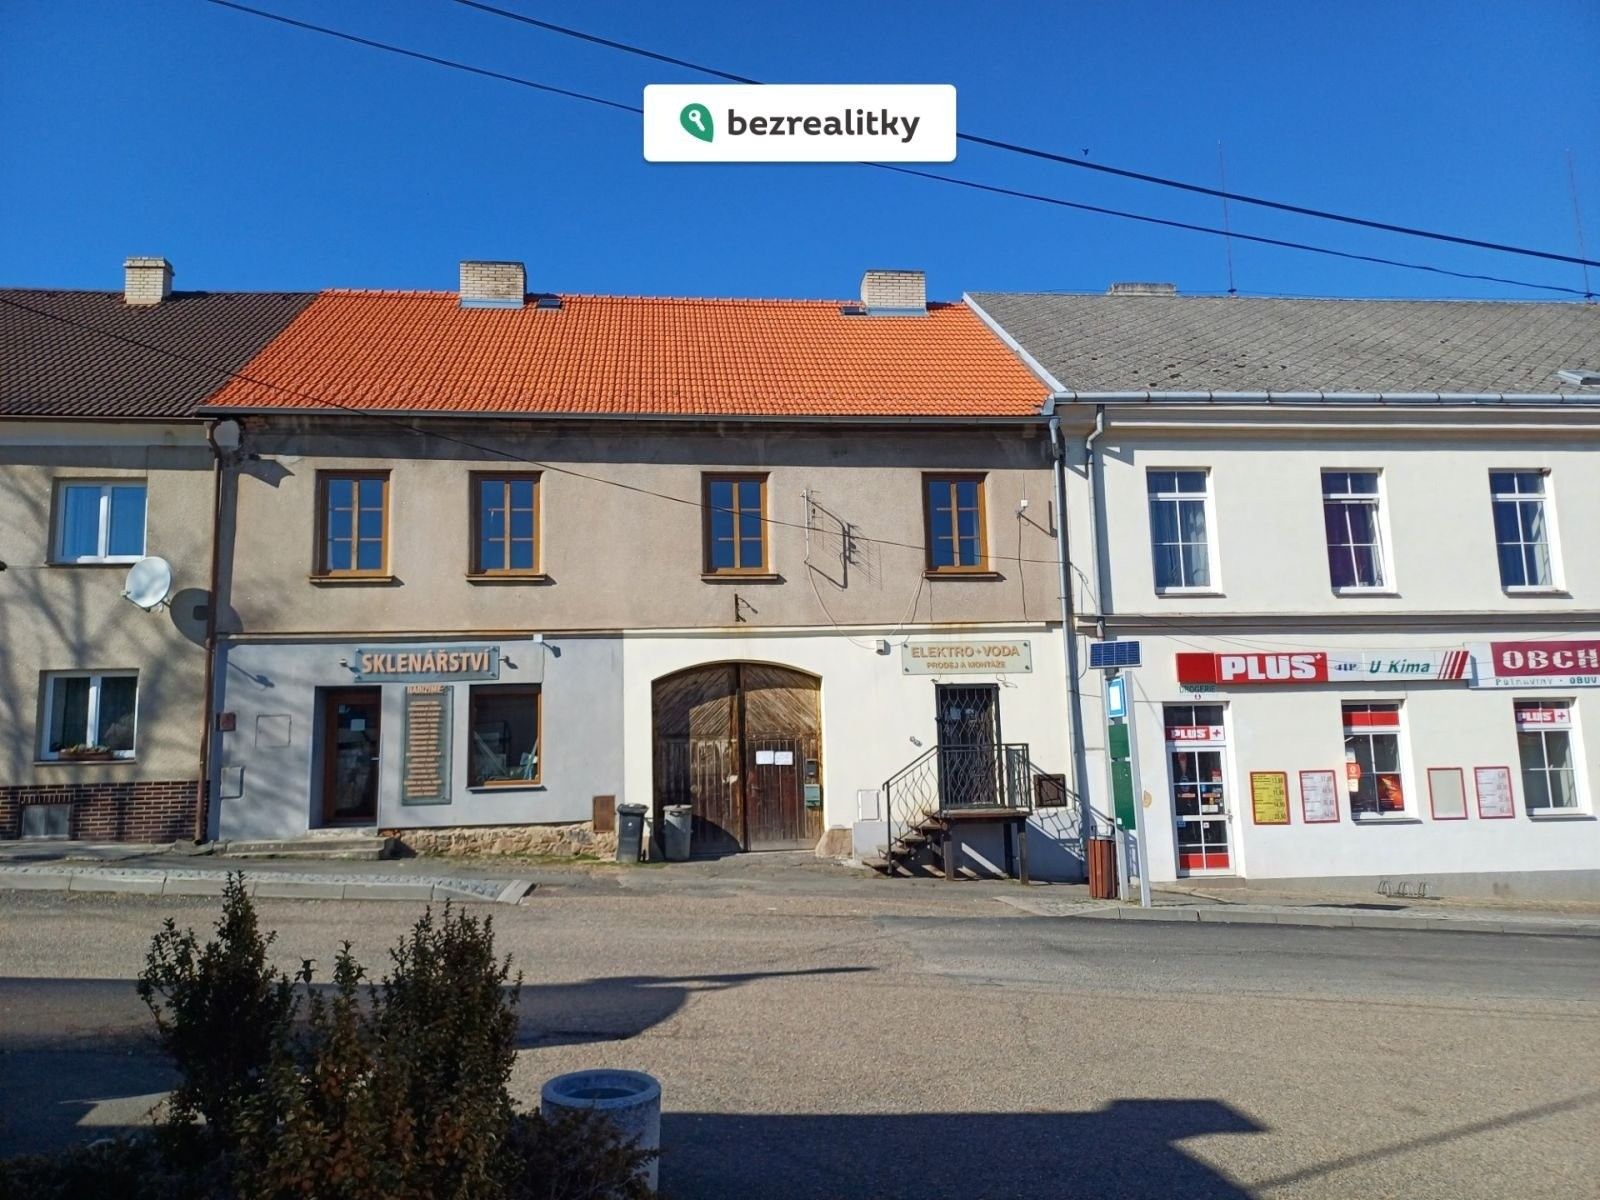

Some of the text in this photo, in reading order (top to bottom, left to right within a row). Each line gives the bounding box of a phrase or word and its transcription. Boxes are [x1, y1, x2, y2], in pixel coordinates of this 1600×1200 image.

[362, 648, 489, 674] SKLENÁŘSTVÍ
[1369, 659, 1430, 673] U Kima
